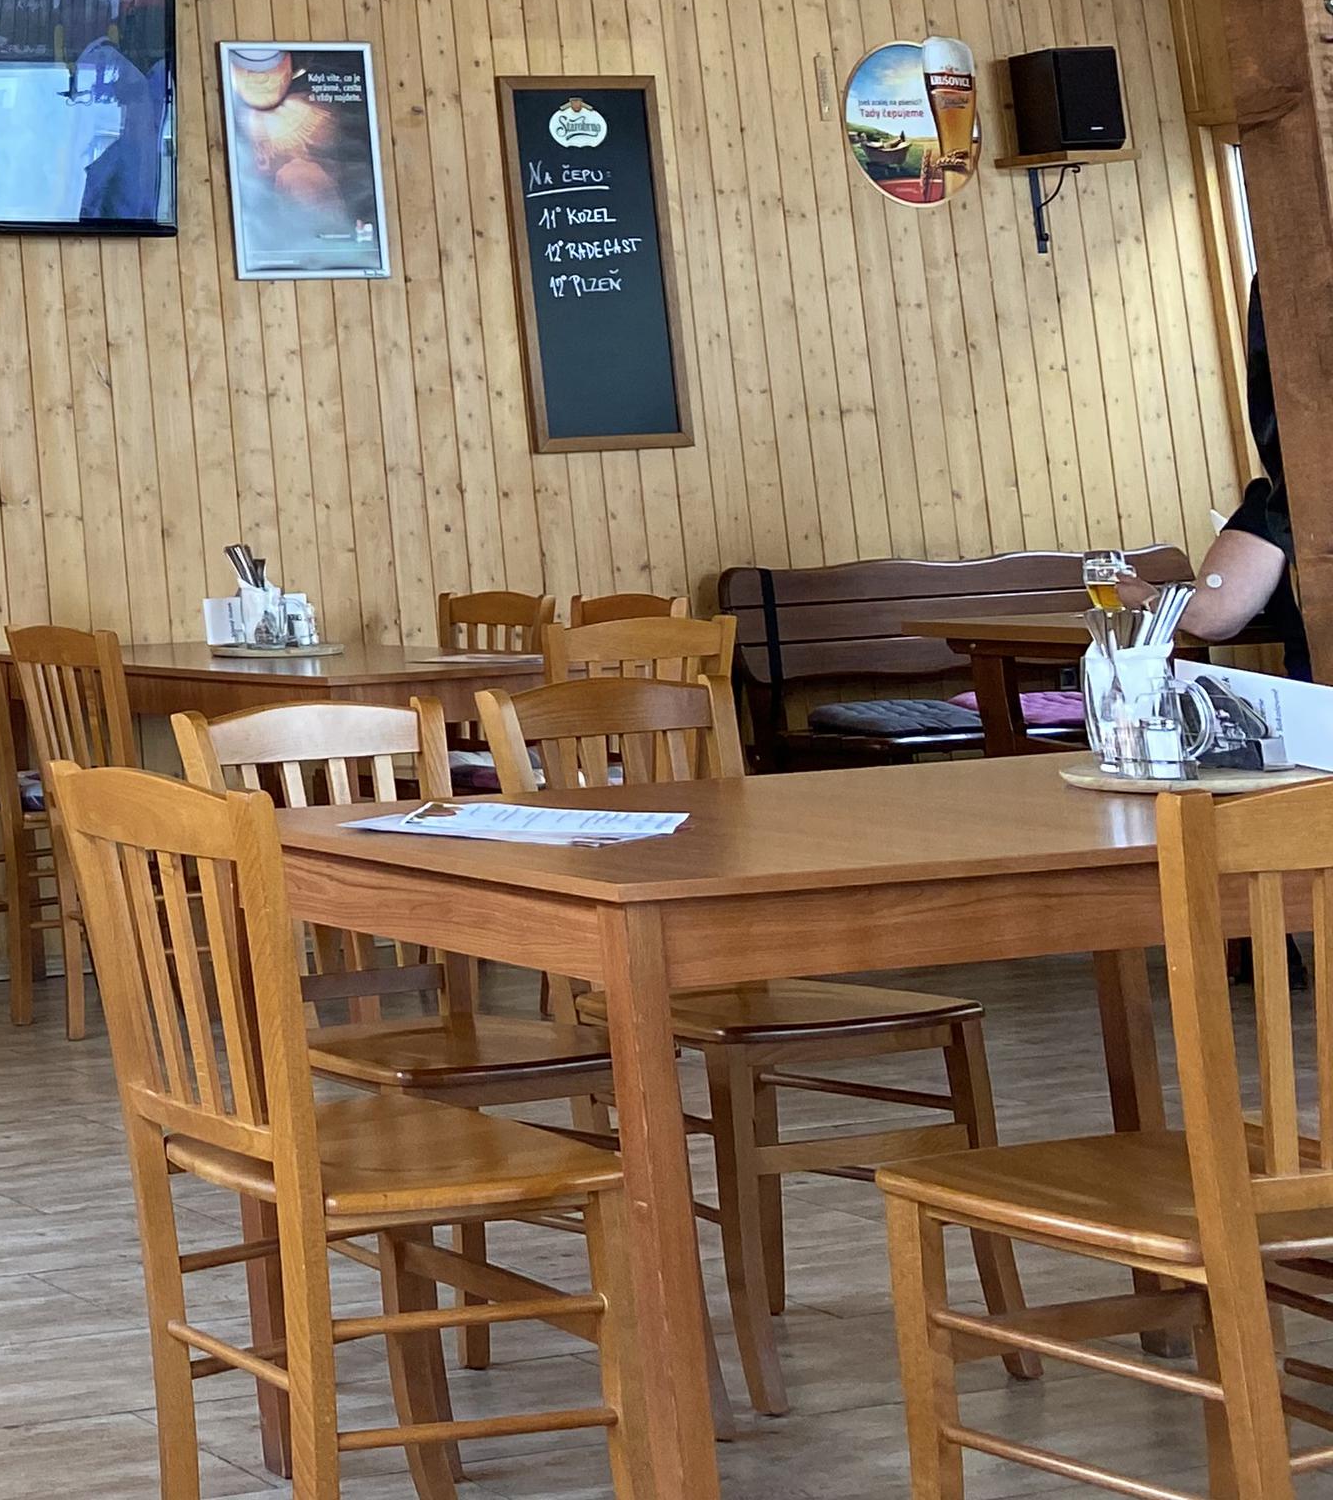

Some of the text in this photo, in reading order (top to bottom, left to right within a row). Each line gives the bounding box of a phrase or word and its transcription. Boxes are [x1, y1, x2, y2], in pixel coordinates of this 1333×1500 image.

[860, 108, 880, 119] Tady
[566, 207, 618, 225] KOZEL
[565, 238, 642, 261] RADEGAST
[567, 269, 623, 297] PLZEŇ
